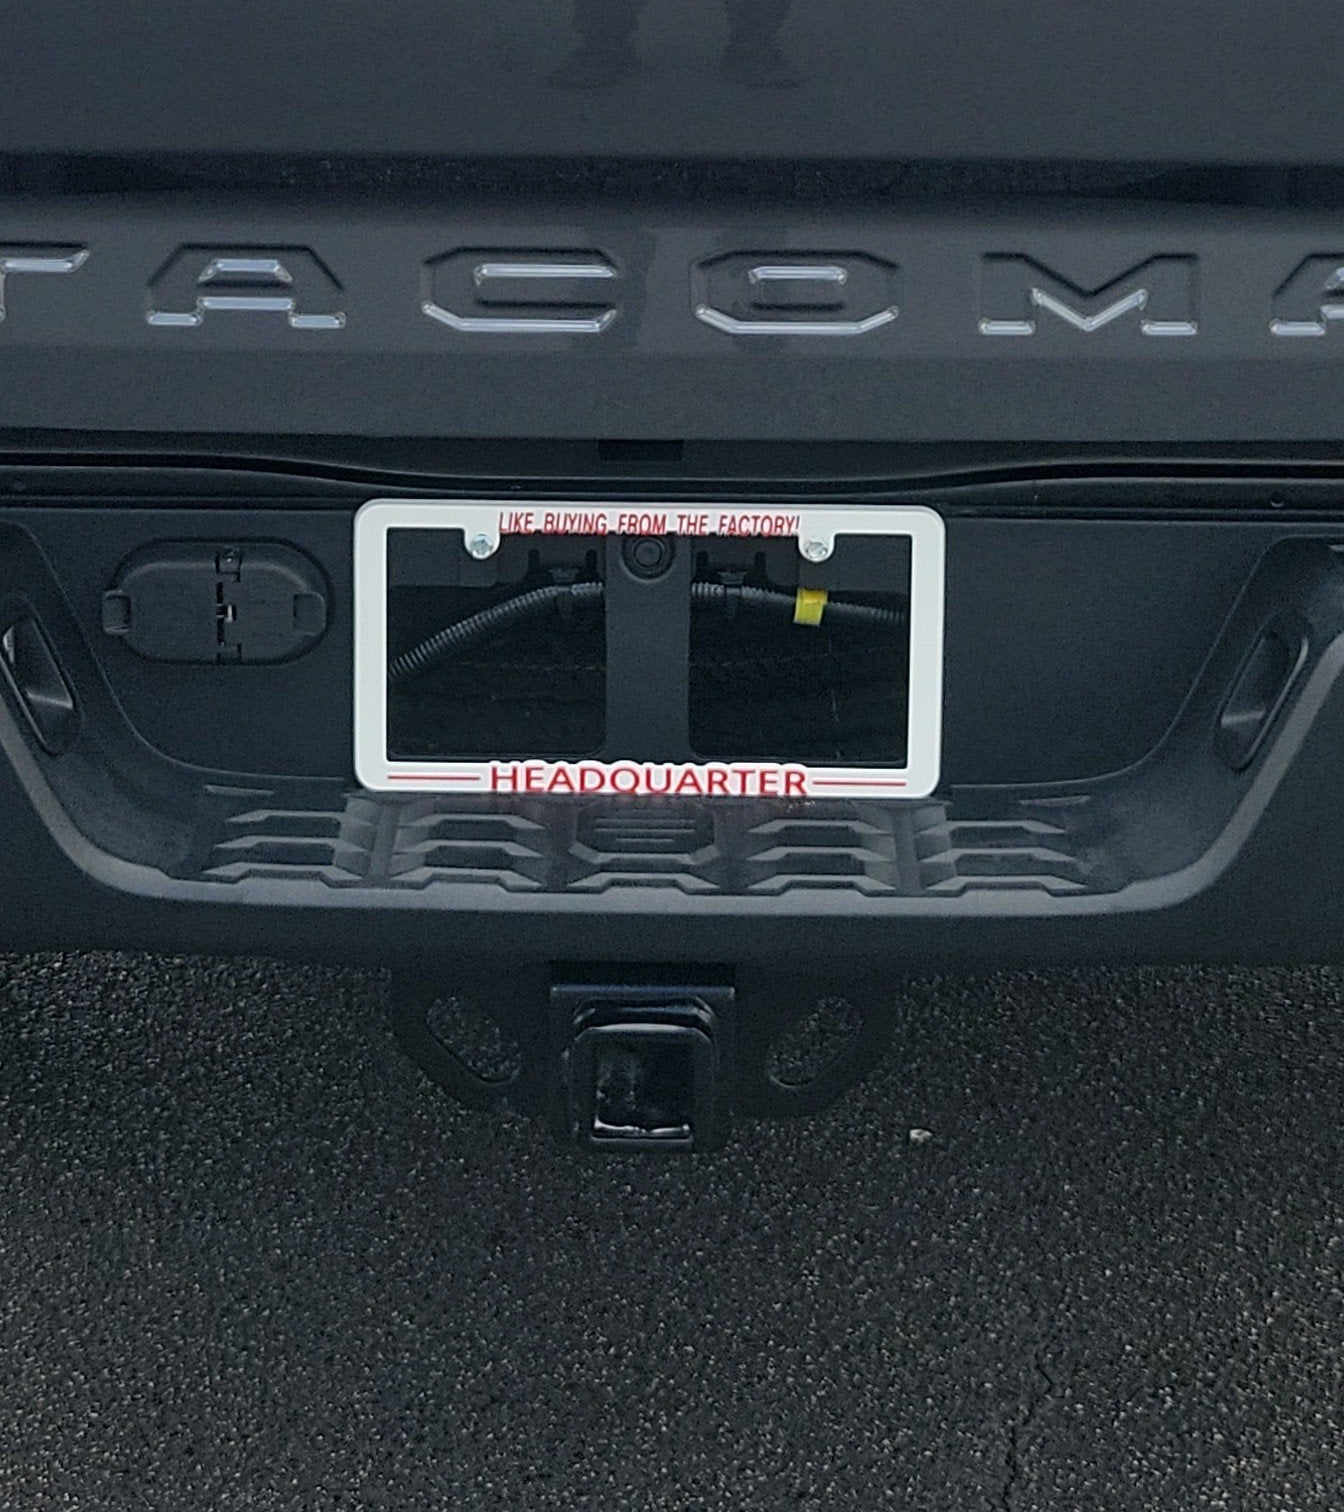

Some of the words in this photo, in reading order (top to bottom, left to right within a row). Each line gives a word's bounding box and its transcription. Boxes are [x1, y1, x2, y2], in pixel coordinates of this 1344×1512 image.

[499, 511, 534, 533] LIKE
[544, 512, 607, 535] BUYING
[618, 513, 666, 535] FROM
[677, 514, 707, 535] THE
[719, 514, 800, 536] FACTORY!
[490, 765, 807, 795] HEADQUARTER
